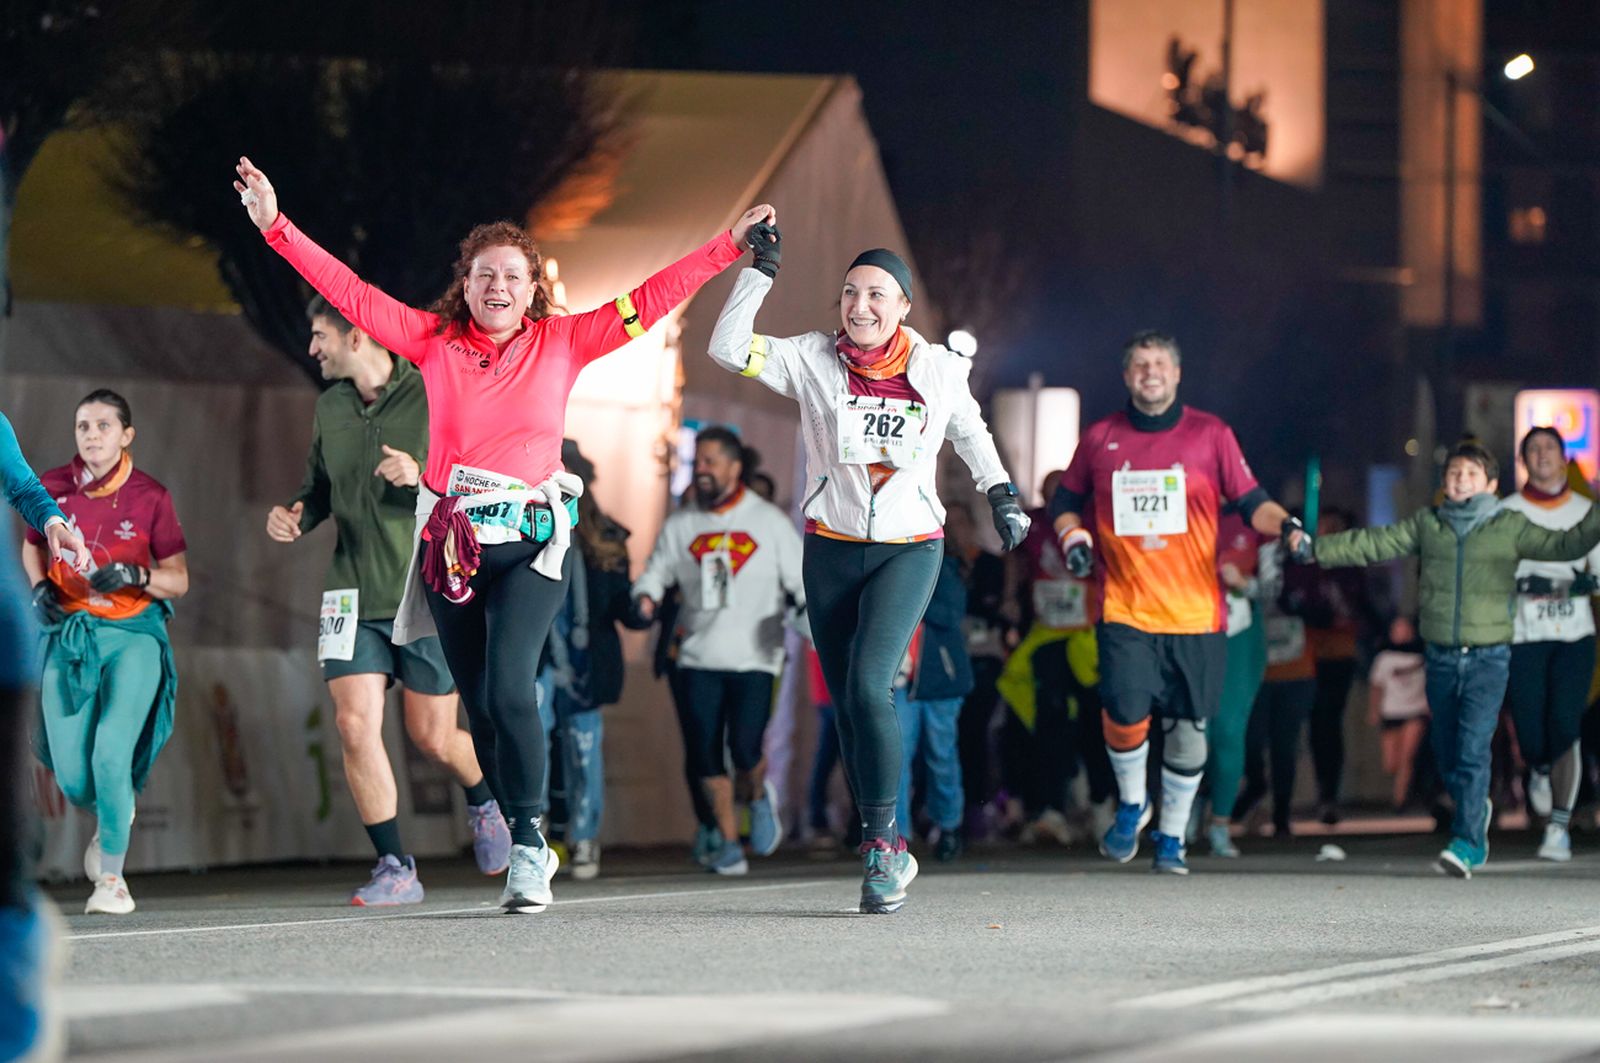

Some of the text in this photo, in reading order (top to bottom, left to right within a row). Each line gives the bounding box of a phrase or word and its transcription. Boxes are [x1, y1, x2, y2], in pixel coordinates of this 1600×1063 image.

[863, 413, 906, 438] 262
[454, 483, 471, 494] SAN
[464, 475, 490, 488] NOCHE
[1132, 495, 1168, 512] 1221
